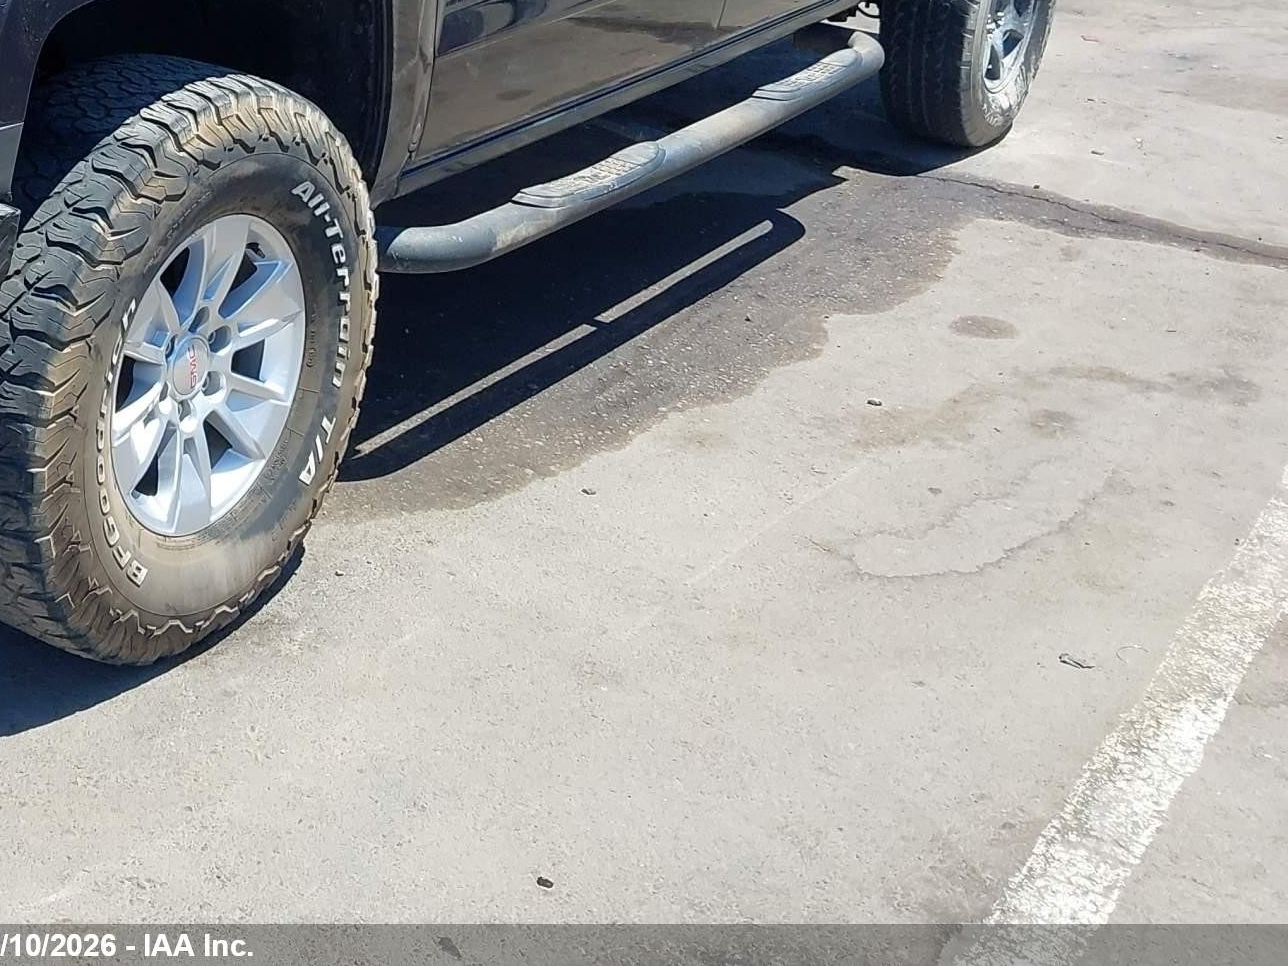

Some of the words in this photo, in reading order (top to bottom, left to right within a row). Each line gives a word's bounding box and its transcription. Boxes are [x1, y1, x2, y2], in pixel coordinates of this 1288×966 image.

[291, 180, 351, 389] All-Terrain
[187, 344, 198, 389] GMC
[298, 415, 337, 486] T/A
